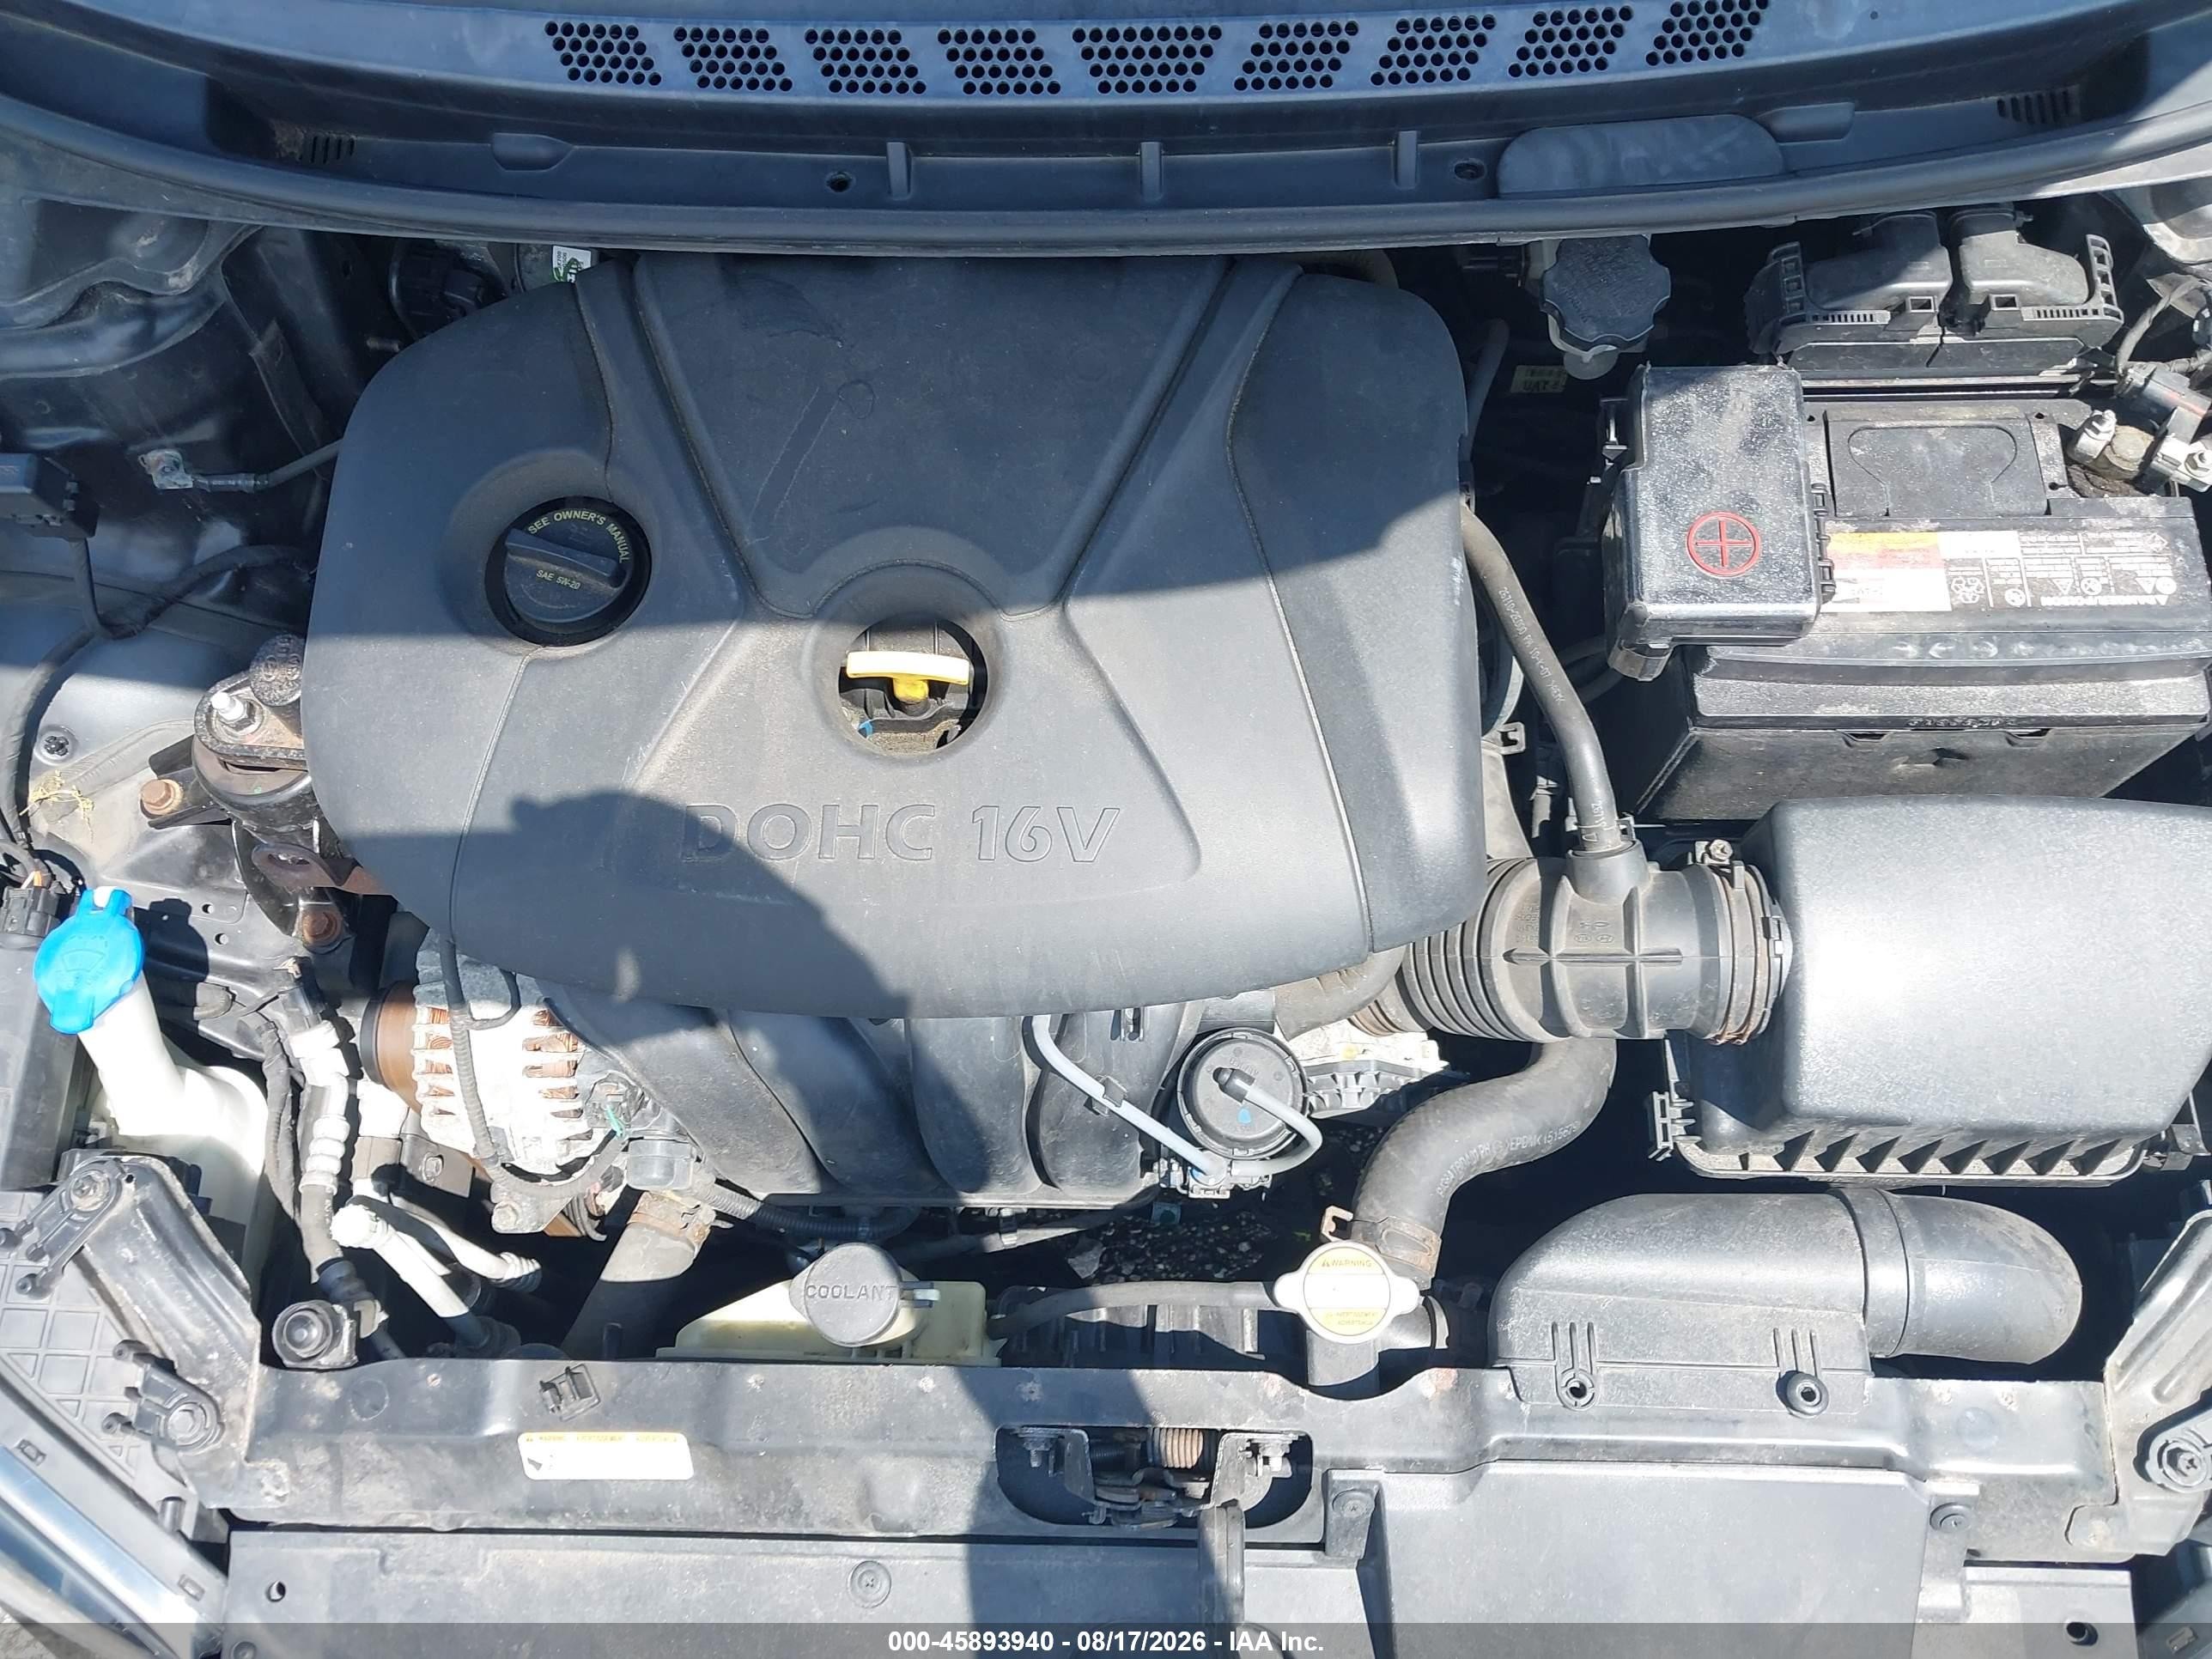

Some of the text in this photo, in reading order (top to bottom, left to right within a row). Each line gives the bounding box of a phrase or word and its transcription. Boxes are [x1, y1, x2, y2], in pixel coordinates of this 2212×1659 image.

[528, 510, 630, 563] SEE OWNER'S MANUAL
[536, 570, 581, 590] SAE 5W-20
[684, 803, 1121, 862] DOHC 16V
[805, 1285, 898, 1301] COOLANT
